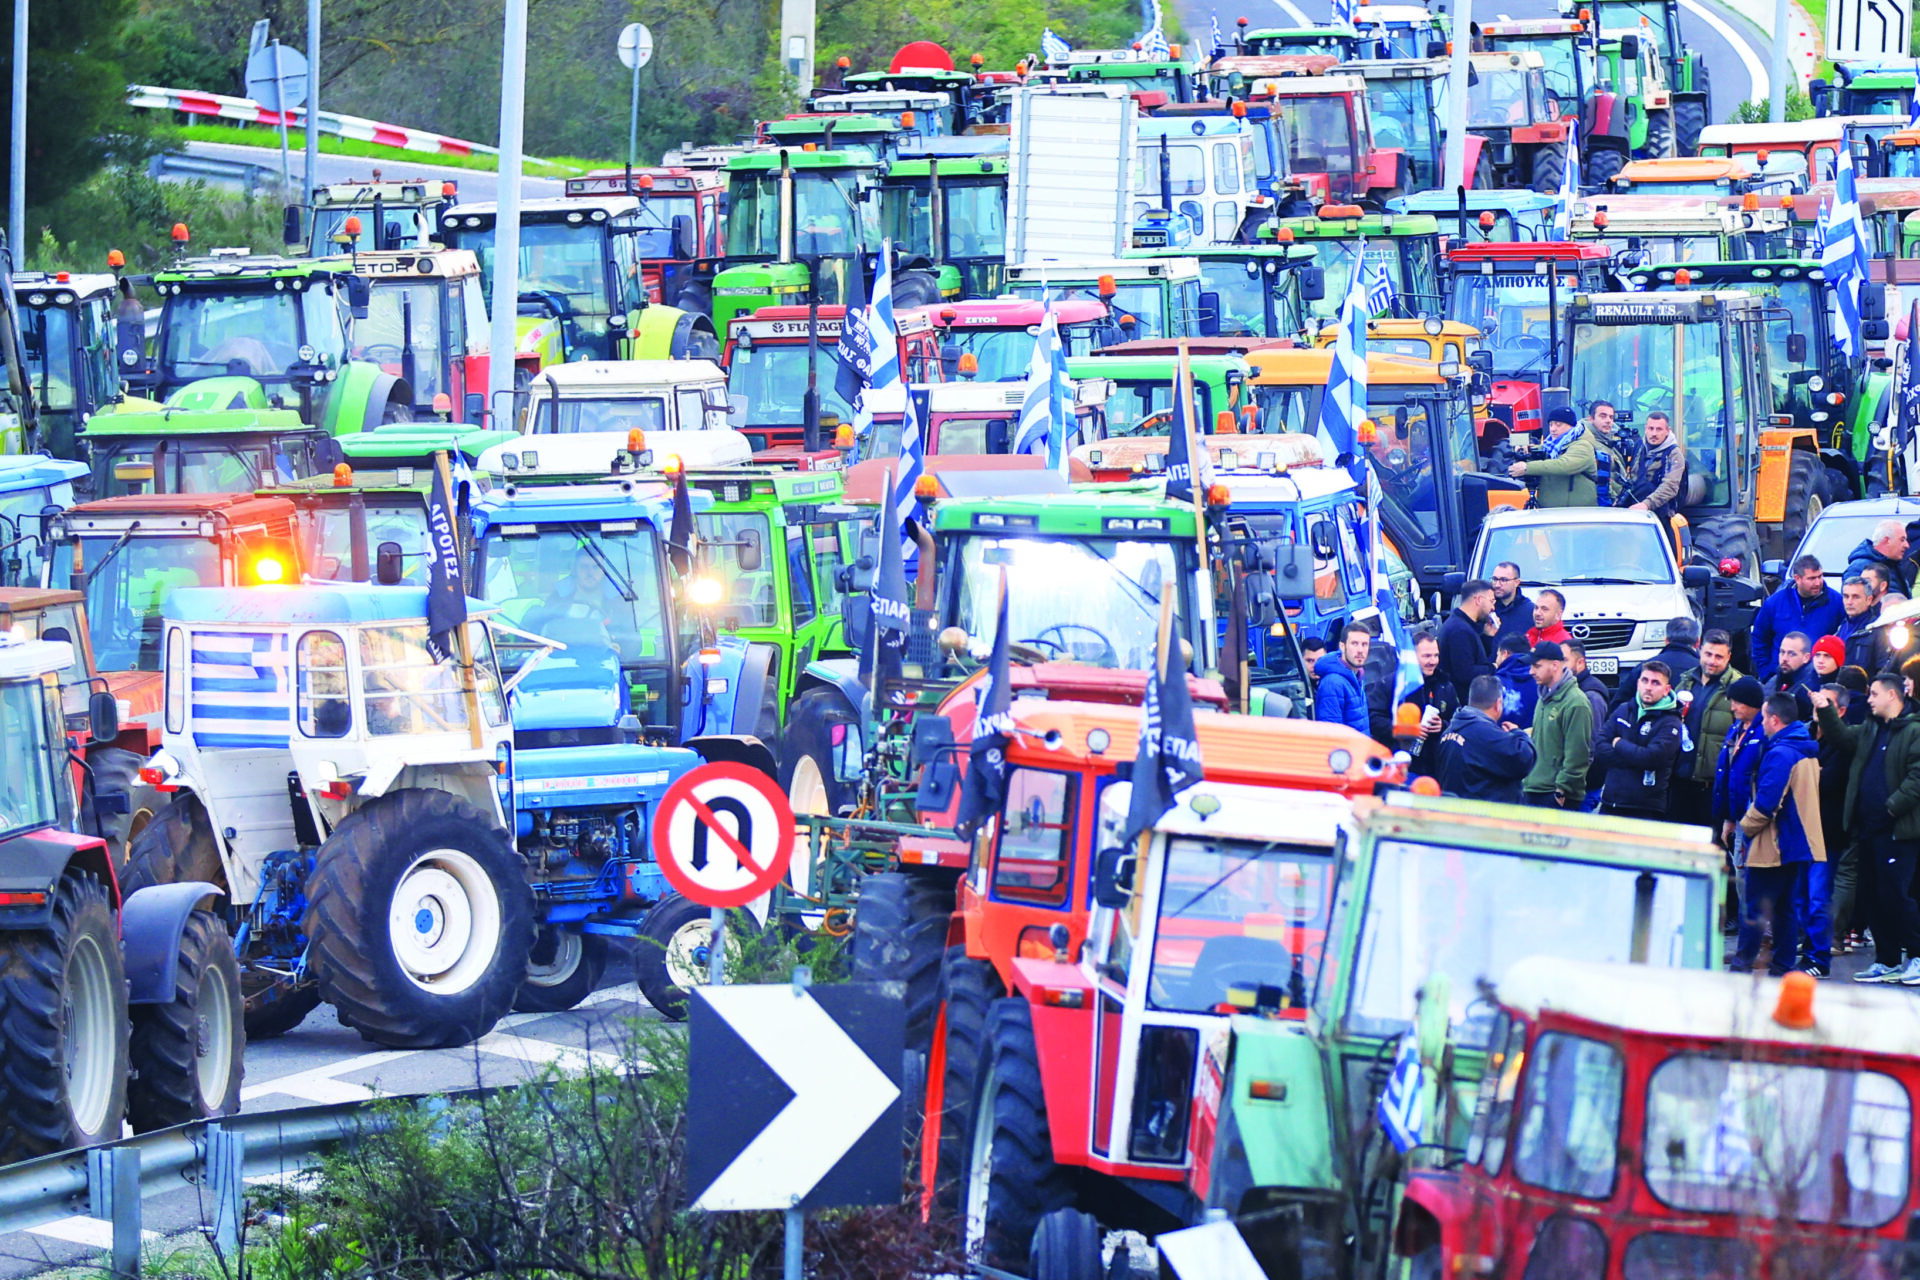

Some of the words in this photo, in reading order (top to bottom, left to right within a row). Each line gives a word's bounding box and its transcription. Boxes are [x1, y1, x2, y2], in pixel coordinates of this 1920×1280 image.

[354, 263, 409, 273] ETOR
[1595, 304, 1655, 316] RENAULT
[964, 316, 998, 324] ZETOR
[787, 322, 844, 332] FIAAG
